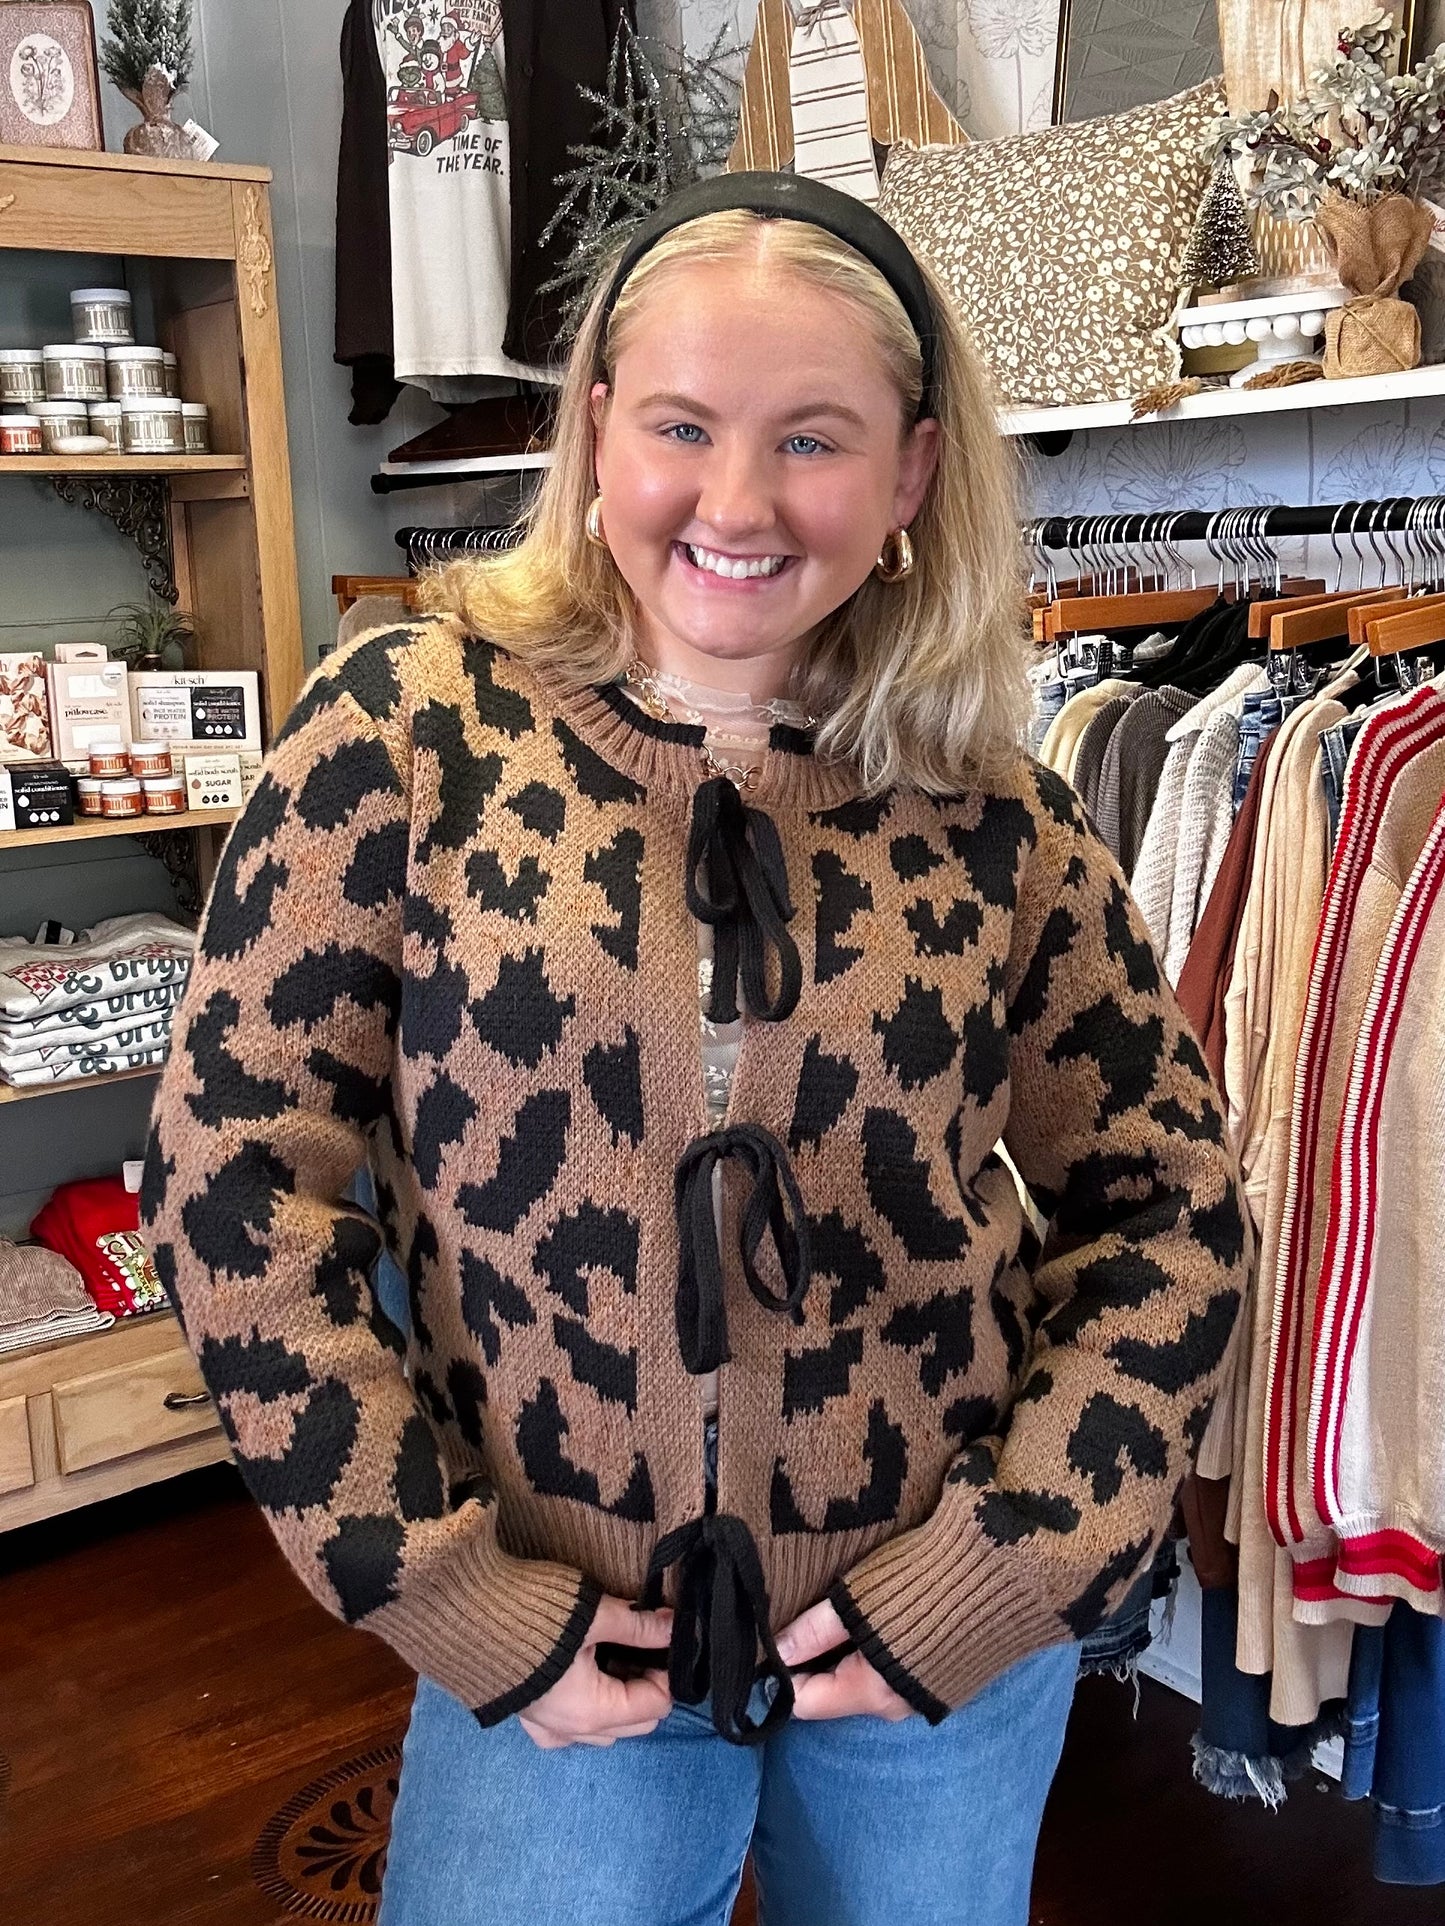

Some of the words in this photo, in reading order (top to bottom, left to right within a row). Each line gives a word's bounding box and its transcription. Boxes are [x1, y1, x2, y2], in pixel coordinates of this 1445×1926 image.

[452, 134, 481, 152] TIME
[484, 137, 503, 154] OF
[436, 154, 460, 173] THE
[463, 153, 504, 175] YEAR.
